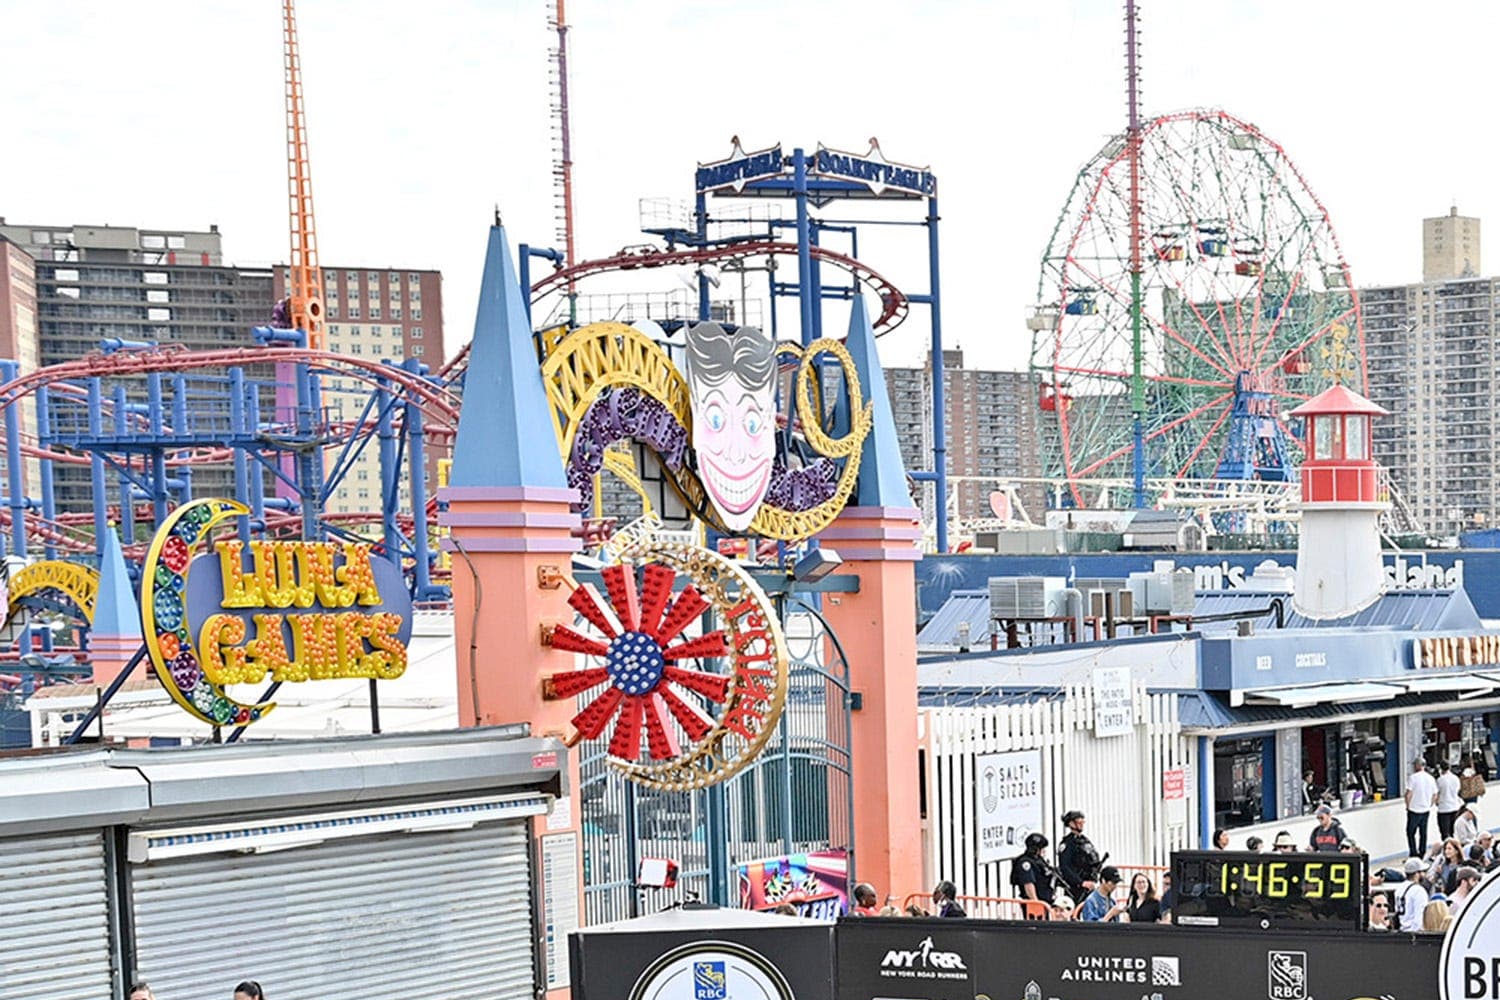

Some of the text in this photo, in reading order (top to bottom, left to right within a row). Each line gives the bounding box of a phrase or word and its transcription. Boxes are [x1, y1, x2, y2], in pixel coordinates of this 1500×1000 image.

[213, 540, 383, 609] LUNA
[199, 611, 409, 685] GAMES
[1000, 780, 1037, 800] SIZZLE
[982, 825, 1004, 840] ENTER
[1077, 955, 1147, 971] UNITED
[1060, 968, 1148, 984] AIRLINES
[697, 988, 724, 1000] RBC
[1273, 985, 1303, 999] RBC
